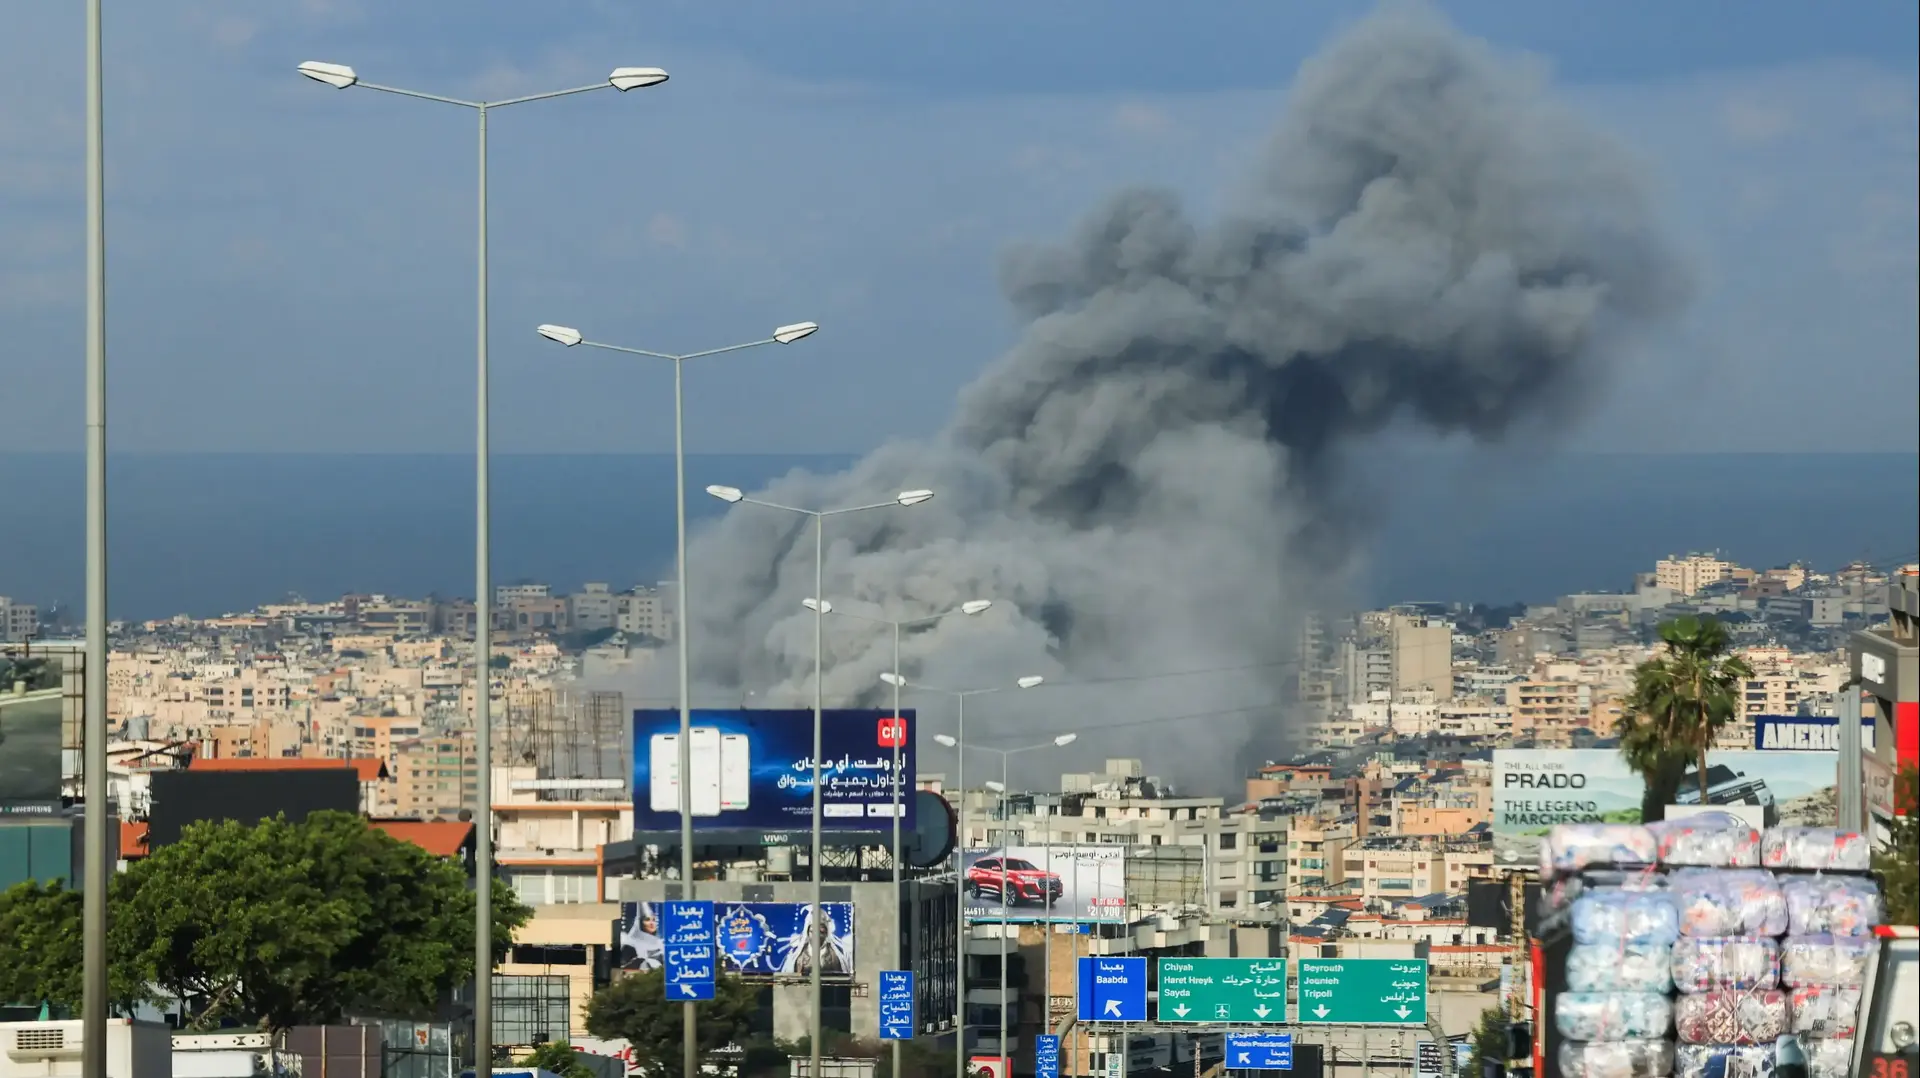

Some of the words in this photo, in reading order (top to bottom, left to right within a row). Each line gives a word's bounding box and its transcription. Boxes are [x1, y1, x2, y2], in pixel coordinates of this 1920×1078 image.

[1762, 722, 1875, 752] AMERICN
[830, 776, 868, 790] جميع
[1503, 773, 1586, 789] PRADO
[1504, 800, 1533, 812] THE
[1536, 800, 1598, 812] LEGEND
[1504, 813, 1580, 825] MARCHES
[672, 903, 704, 919] بعبدا
[676, 920, 703, 932] القصر
[668, 930, 711, 943] الجمهوري
[668, 946, 711, 966] الشياح
[1100, 961, 1124, 973] بعبدا
[1164, 963, 1193, 973] Chiyah
[1249, 962, 1281, 974] الشياح
[1303, 963, 1344, 974] Beyrouth
[1389, 963, 1421, 974] بيروت
[670, 965, 710, 983] المطار
[885, 972, 907, 984] بعبدا
[1096, 975, 1128, 984] Baabda
[1164, 976, 1187, 984] Haret
[1221, 974, 1254, 986] حريك
[1255, 975, 1281, 986] حارة
[1303, 976, 1340, 985] Jounieh
[1391, 979, 1421, 990] جونيه
[888, 984, 906, 993] القصر
[1164, 989, 1191, 999] Sayda
[1253, 988, 1281, 999] صيدا
[1304, 989, 1333, 999] Tripoli
[881, 991, 911, 1000] الجمهوري
[1380, 991, 1421, 1004] طرابلس
[881, 1001, 911, 1015] الشياح
[883, 1014, 910, 1027] المطار
[1040, 1036, 1054, 1044] بعبدا
[1270, 1048, 1290, 1058] بعبدا
